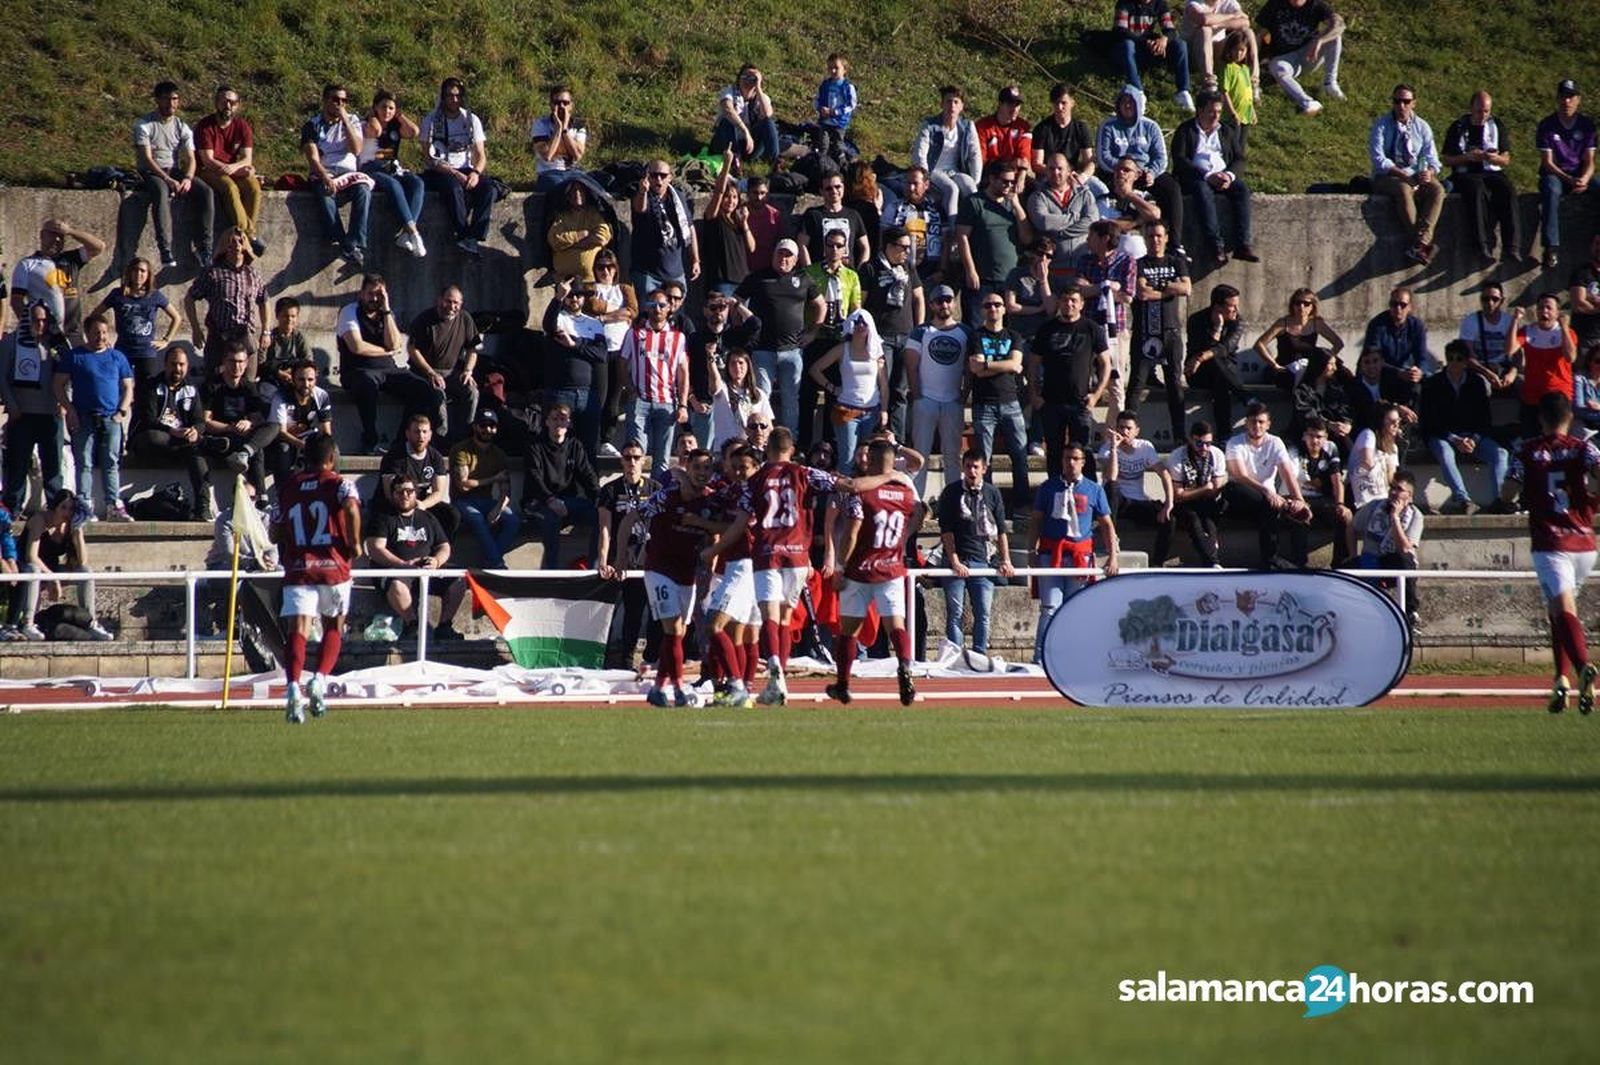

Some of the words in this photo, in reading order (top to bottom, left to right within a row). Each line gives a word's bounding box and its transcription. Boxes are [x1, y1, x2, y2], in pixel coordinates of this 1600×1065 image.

[762, 488, 797, 529] 23
[1548, 471, 1570, 513] 5
[288, 501, 332, 546] 12
[655, 585, 669, 601] 16
[1176, 618, 1315, 656] Dialgasa
[1102, 683, 1196, 705] Piensos
[1204, 683, 1234, 705] de
[1243, 683, 1348, 707] Calidad
